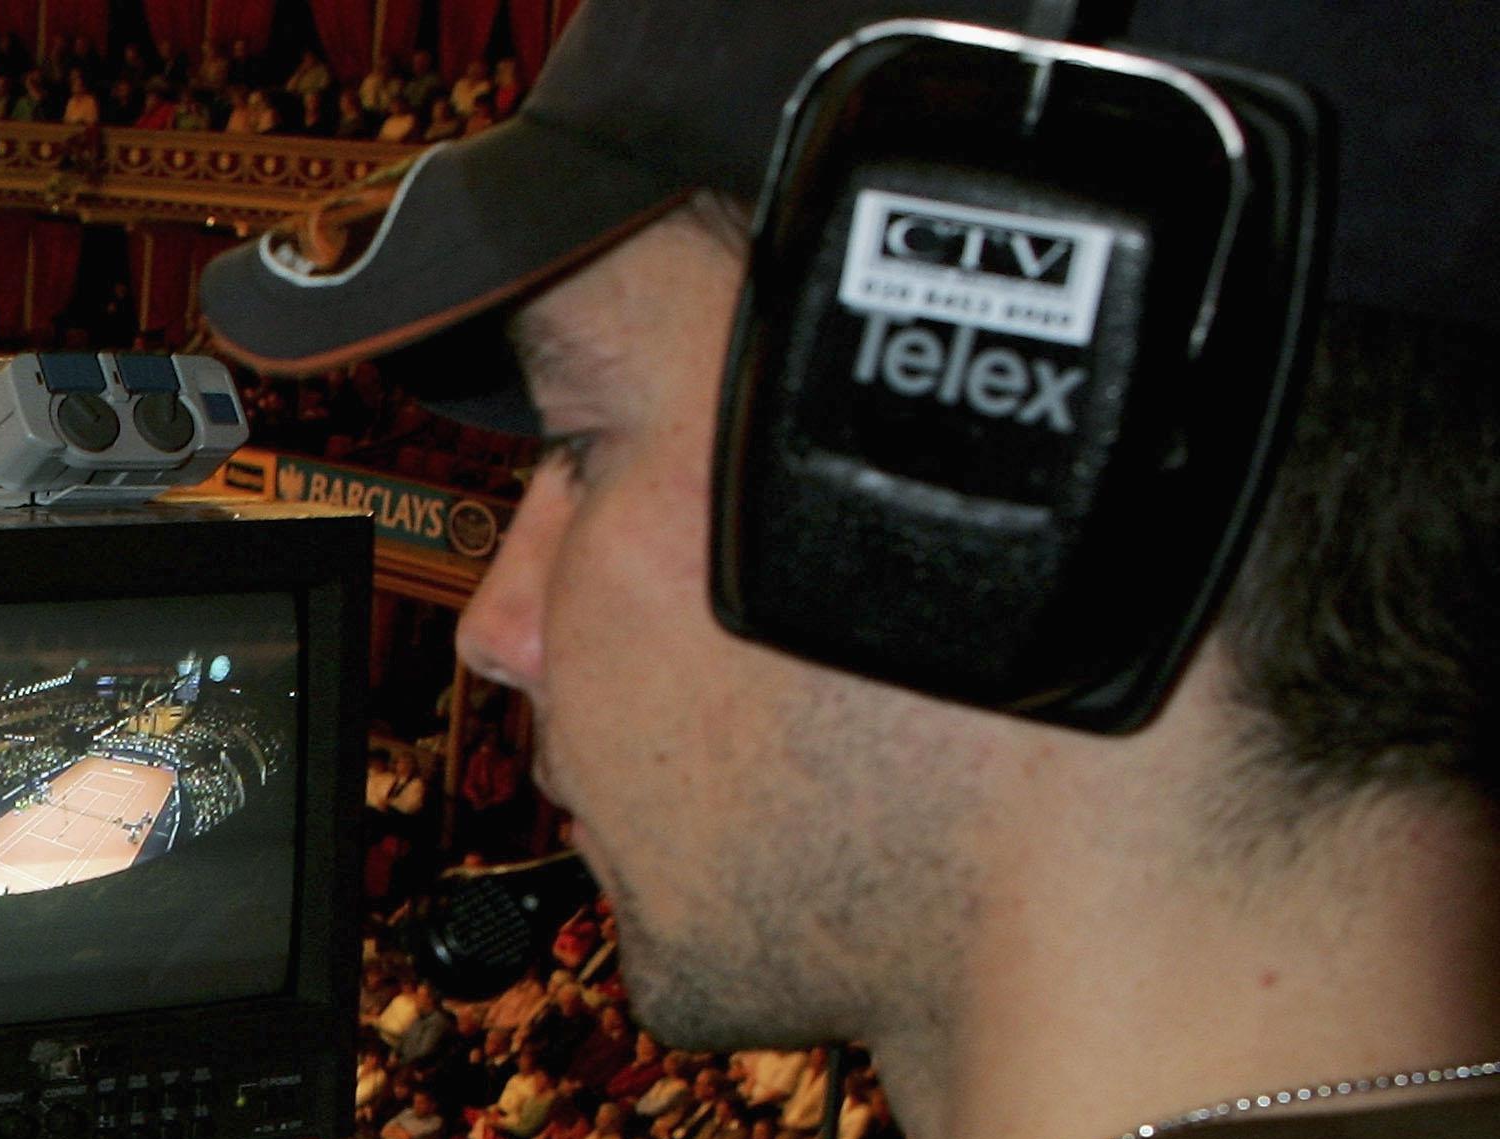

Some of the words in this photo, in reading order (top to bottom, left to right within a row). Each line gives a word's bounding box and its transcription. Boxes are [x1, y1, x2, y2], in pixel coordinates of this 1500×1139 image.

[885, 214, 1075, 279] CTV
[853, 312, 1087, 432] Telex
[307, 472, 445, 540] BARCLAYS
